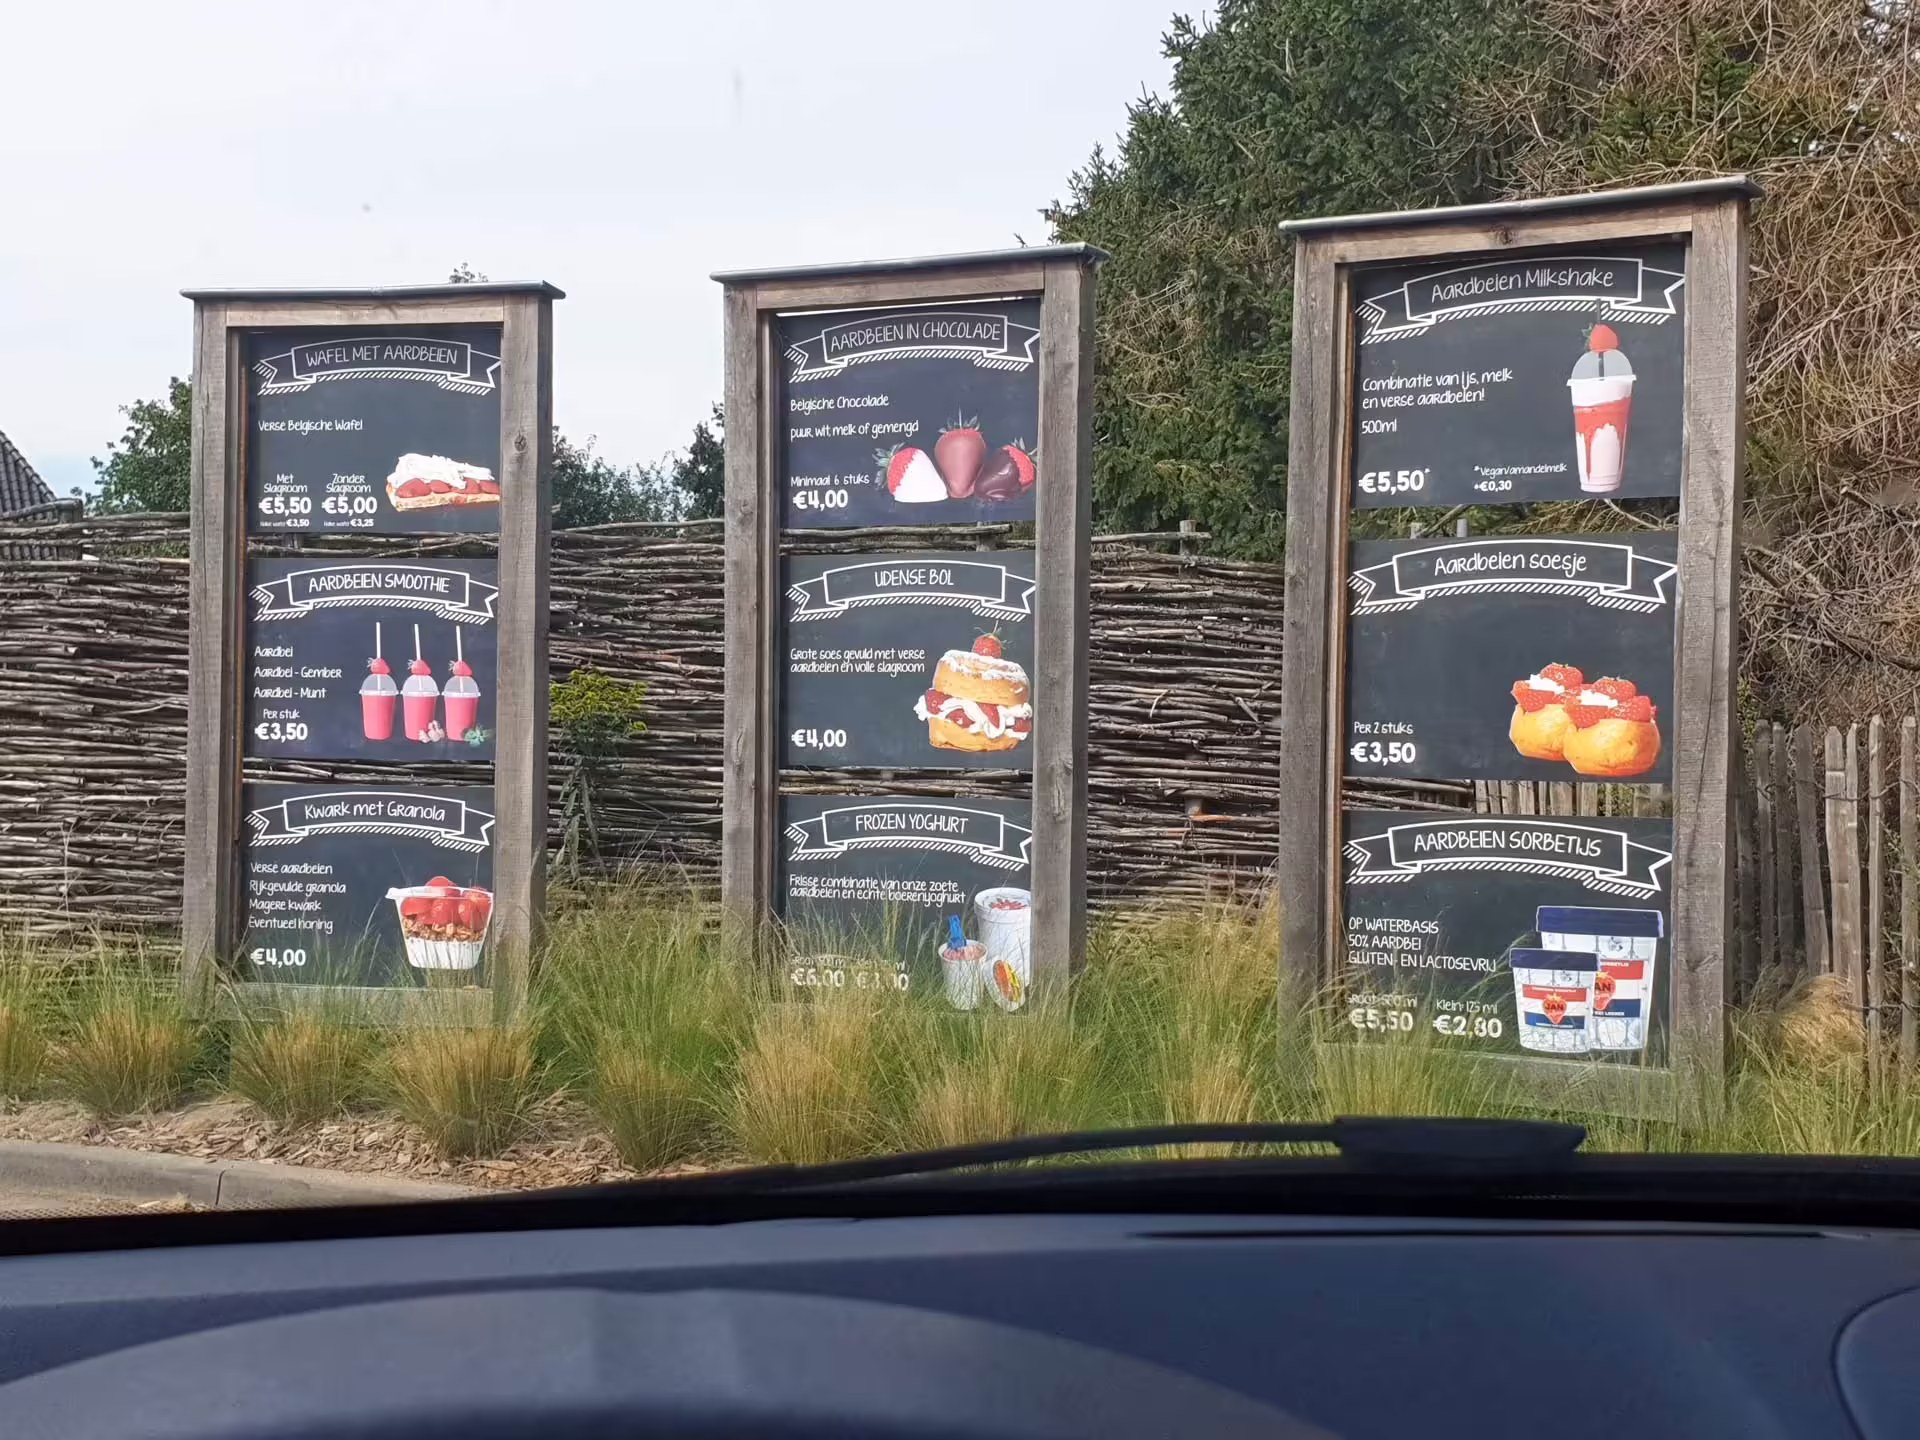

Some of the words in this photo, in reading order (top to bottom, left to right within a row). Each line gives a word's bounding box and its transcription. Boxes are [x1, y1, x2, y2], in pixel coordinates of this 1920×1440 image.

[1432, 273, 1521, 302] Aardbeien
[1525, 267, 1614, 289] Milkshake
[831, 324, 904, 352] AARDBEIEN
[907, 323, 919, 338] IN
[922, 322, 1001, 341] CHOCOLADE
[306, 348, 350, 367] WAFEL
[352, 346, 380, 360] MET
[384, 345, 457, 365] AARDBEIEN
[1362, 373, 1433, 392] Combinatie
[1436, 374, 1460, 387] van
[1482, 368, 1513, 383] melk
[791, 397, 835, 415] Belgische
[837, 394, 889, 409] Chocolade
[1362, 396, 1378, 409] en
[1381, 394, 1414, 408] verse
[1417, 388, 1485, 406] aardbeien!
[258, 420, 286, 431] Verse
[288, 419, 332, 435] Belgische
[334, 419, 363, 431] Wafel
[832, 422, 856, 436] melk
[858, 423, 870, 435] of
[872, 420, 919, 439] gemengd
[1361, 419, 1397, 435] 500ml
[277, 474, 294, 484] Met
[332, 474, 365, 484] Zonder
[791, 476, 830, 487] Minimaal
[834, 475, 840, 485] 6
[843, 474, 870, 485] stuks
[264, 483, 307, 497] Slagroom
[325, 483, 371, 497] Slagroom
[259, 497, 311, 516] €5,50
[321, 497, 377, 516] €5,00
[793, 489, 848, 511] €4,00
[1434, 552, 1526, 576] Aardbeien
[1528, 551, 1587, 578] soesje
[309, 573, 382, 593] AARDBEIEN
[385, 573, 450, 593] SMOOTHIE
[875, 569, 926, 587] UDENSE
[929, 568, 954, 586] BOL
[254, 646, 293, 658] Aardbei
[791, 649, 818, 661] Grote
[820, 650, 842, 660] soes
[844, 648, 873, 664] gevuld
[875, 649, 895, 660] met
[898, 649, 925, 660] verse
[254, 666, 293, 678] Aardbei
[301, 667, 342, 679] Gember
[791, 661, 839, 673] aardbeien
[840, 663, 853, 673] en
[854, 662, 875, 673] volle
[877, 662, 924, 677] slagroom
[253, 687, 292, 699] Aardbei
[301, 687, 327, 699] Munt
[263, 709, 278, 719] Per
[280, 708, 300, 719] stuk
[254, 722, 308, 743] €3,50
[1354, 722, 1371, 735] Per
[1373, 722, 1380, 734] 2
[1382, 721, 1414, 735] stuks
[791, 728, 847, 750] €4,00
[1350, 741, 1416, 766] €3,50
[305, 802, 351, 820] Kwark
[353, 801, 384, 816] met
[387, 801, 445, 822] Granola
[856, 813, 906, 832] FROZEN
[908, 814, 969, 833] YOGHURT
[1414, 830, 1505, 853] AARDBEIEN
[1509, 831, 1602, 857] SORBETIJS
[251, 862, 278, 874] Verse
[280, 863, 333, 874] aardbeien
[306, 882, 346, 898] granola
[790, 874, 819, 887] Frisse
[821, 876, 879, 890] combinatie
[881, 879, 900, 891] van
[902, 879, 927, 891] onze
[929, 879, 959, 892] zoete
[250, 899, 287, 914] Magere
[289, 899, 321, 911] kwark
[790, 887, 840, 899] aardbeien
[842, 890, 855, 899] en
[857, 888, 886, 901] echte
[888, 891, 966, 908] boerenyoghurt
[249, 917, 297, 929] Eventueel
[298, 917, 333, 934] honing
[1349, 917, 1363, 930] OP
[1364, 918, 1439, 934] WATERBASIS
[1349, 933, 1369, 948] 50%
[1372, 936, 1422, 950] AARDBEI
[251, 948, 306, 968] €4,00
[1400, 954, 1417, 967] EN
[1419, 955, 1496, 973] LACTOSEVRIJ
[1595, 983, 1611, 992] AN
[1482, 1003, 1498, 1014] ml
[1350, 1008, 1414, 1033] €5,50
[1433, 1014, 1502, 1039] €2,80
